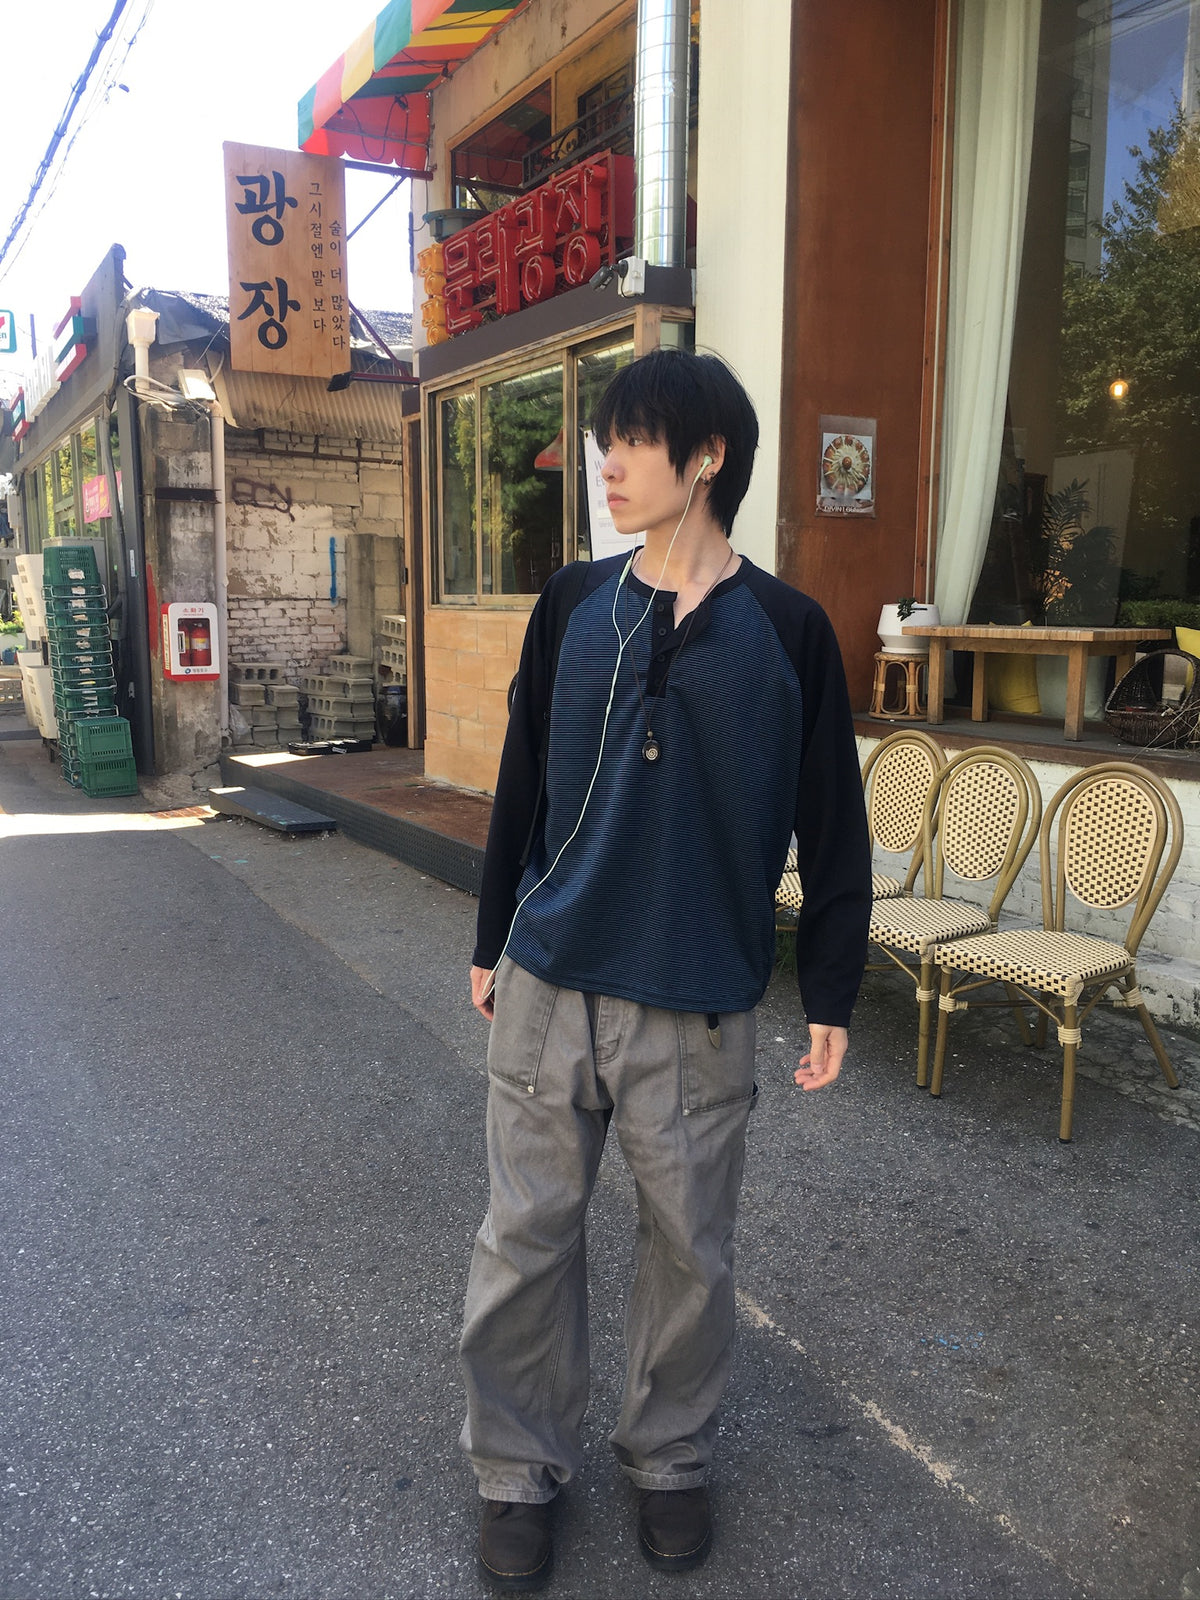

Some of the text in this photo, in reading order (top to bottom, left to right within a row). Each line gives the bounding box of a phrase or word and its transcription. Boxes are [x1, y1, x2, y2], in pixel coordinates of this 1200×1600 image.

[235, 171, 300, 350] 광장
[328, 219, 346, 351] 술이 더 많았다
